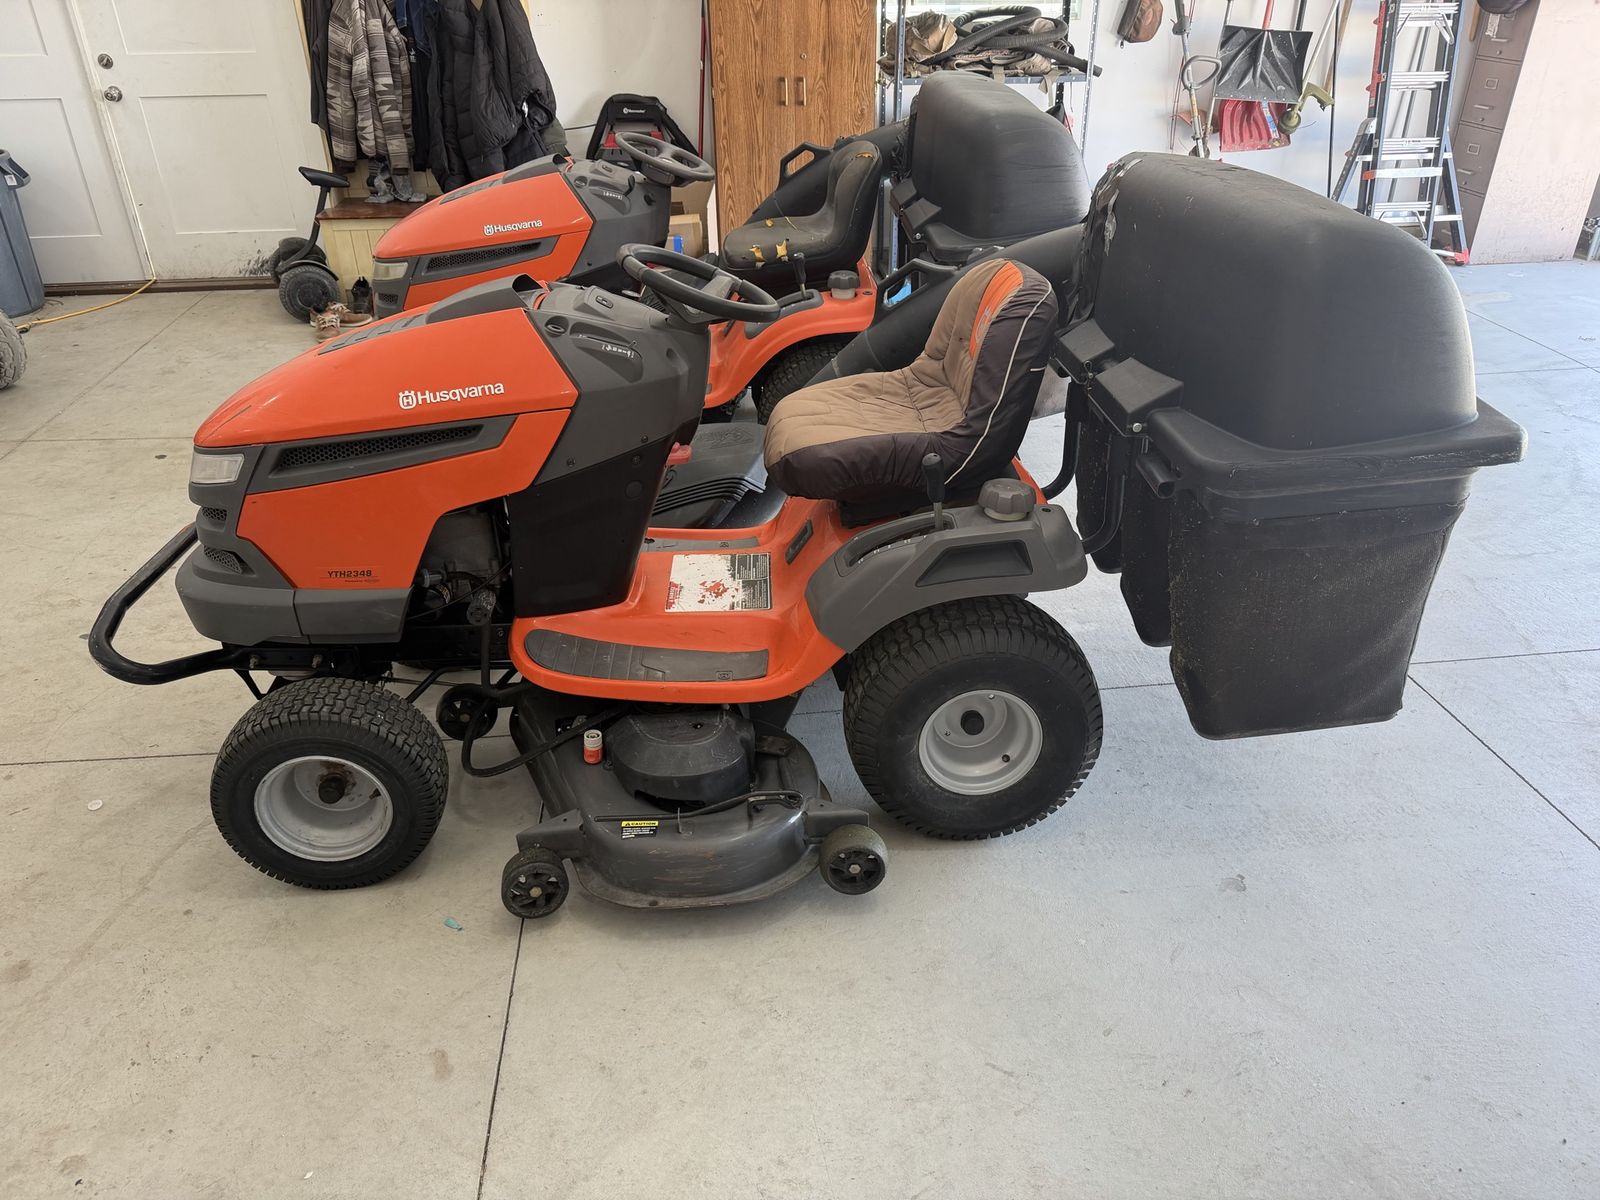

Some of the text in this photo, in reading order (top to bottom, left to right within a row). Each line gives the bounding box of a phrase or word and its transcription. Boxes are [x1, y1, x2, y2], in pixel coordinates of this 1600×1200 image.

[494, 219, 543, 233] Husqvarna
[417, 382, 505, 405] Husqvarna
[328, 569, 372, 578] YTH2348
